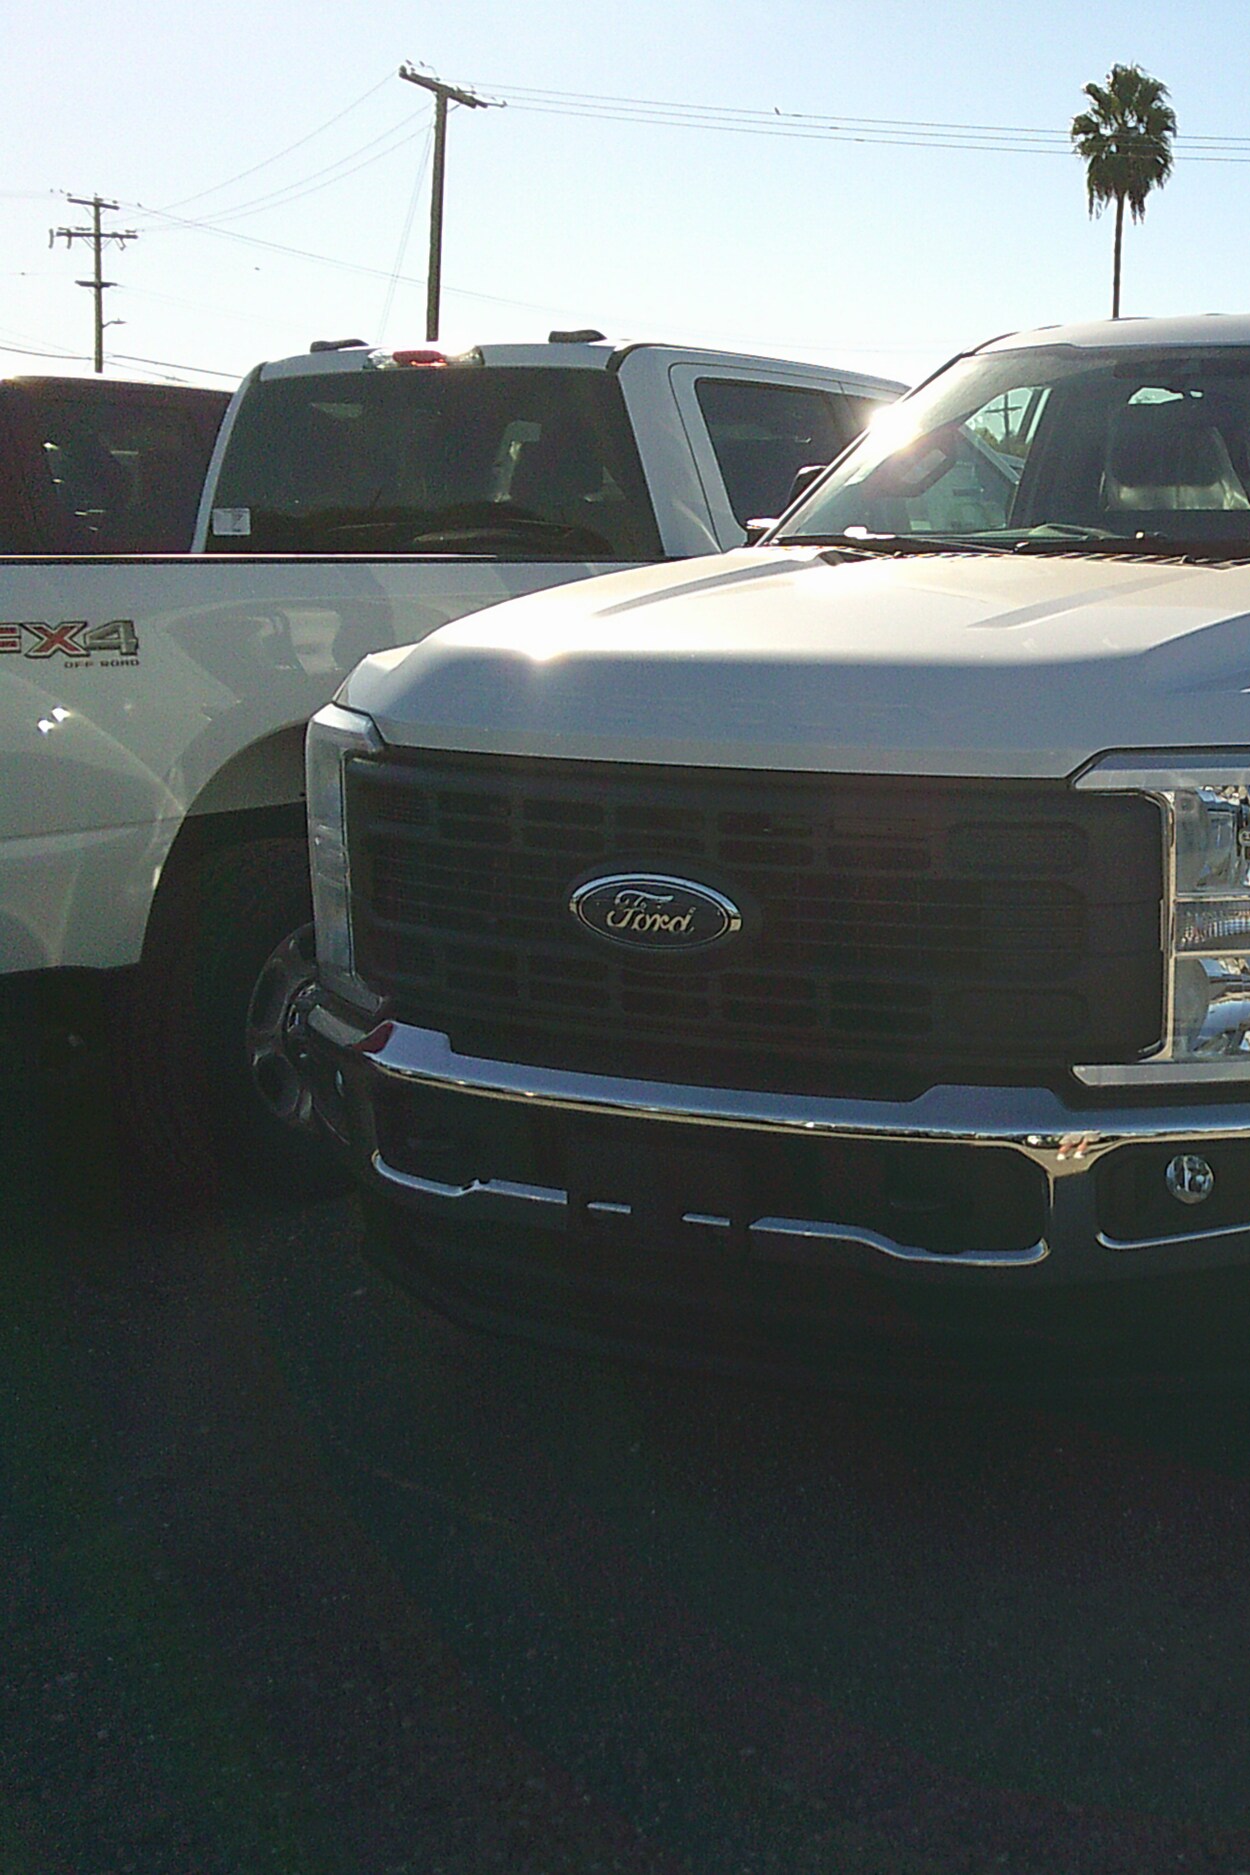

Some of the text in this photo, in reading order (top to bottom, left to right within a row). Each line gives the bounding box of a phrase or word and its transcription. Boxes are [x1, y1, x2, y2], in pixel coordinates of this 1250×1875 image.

[64, 658, 140, 669] OFF ROAD
[606, 889, 697, 934] Ford
